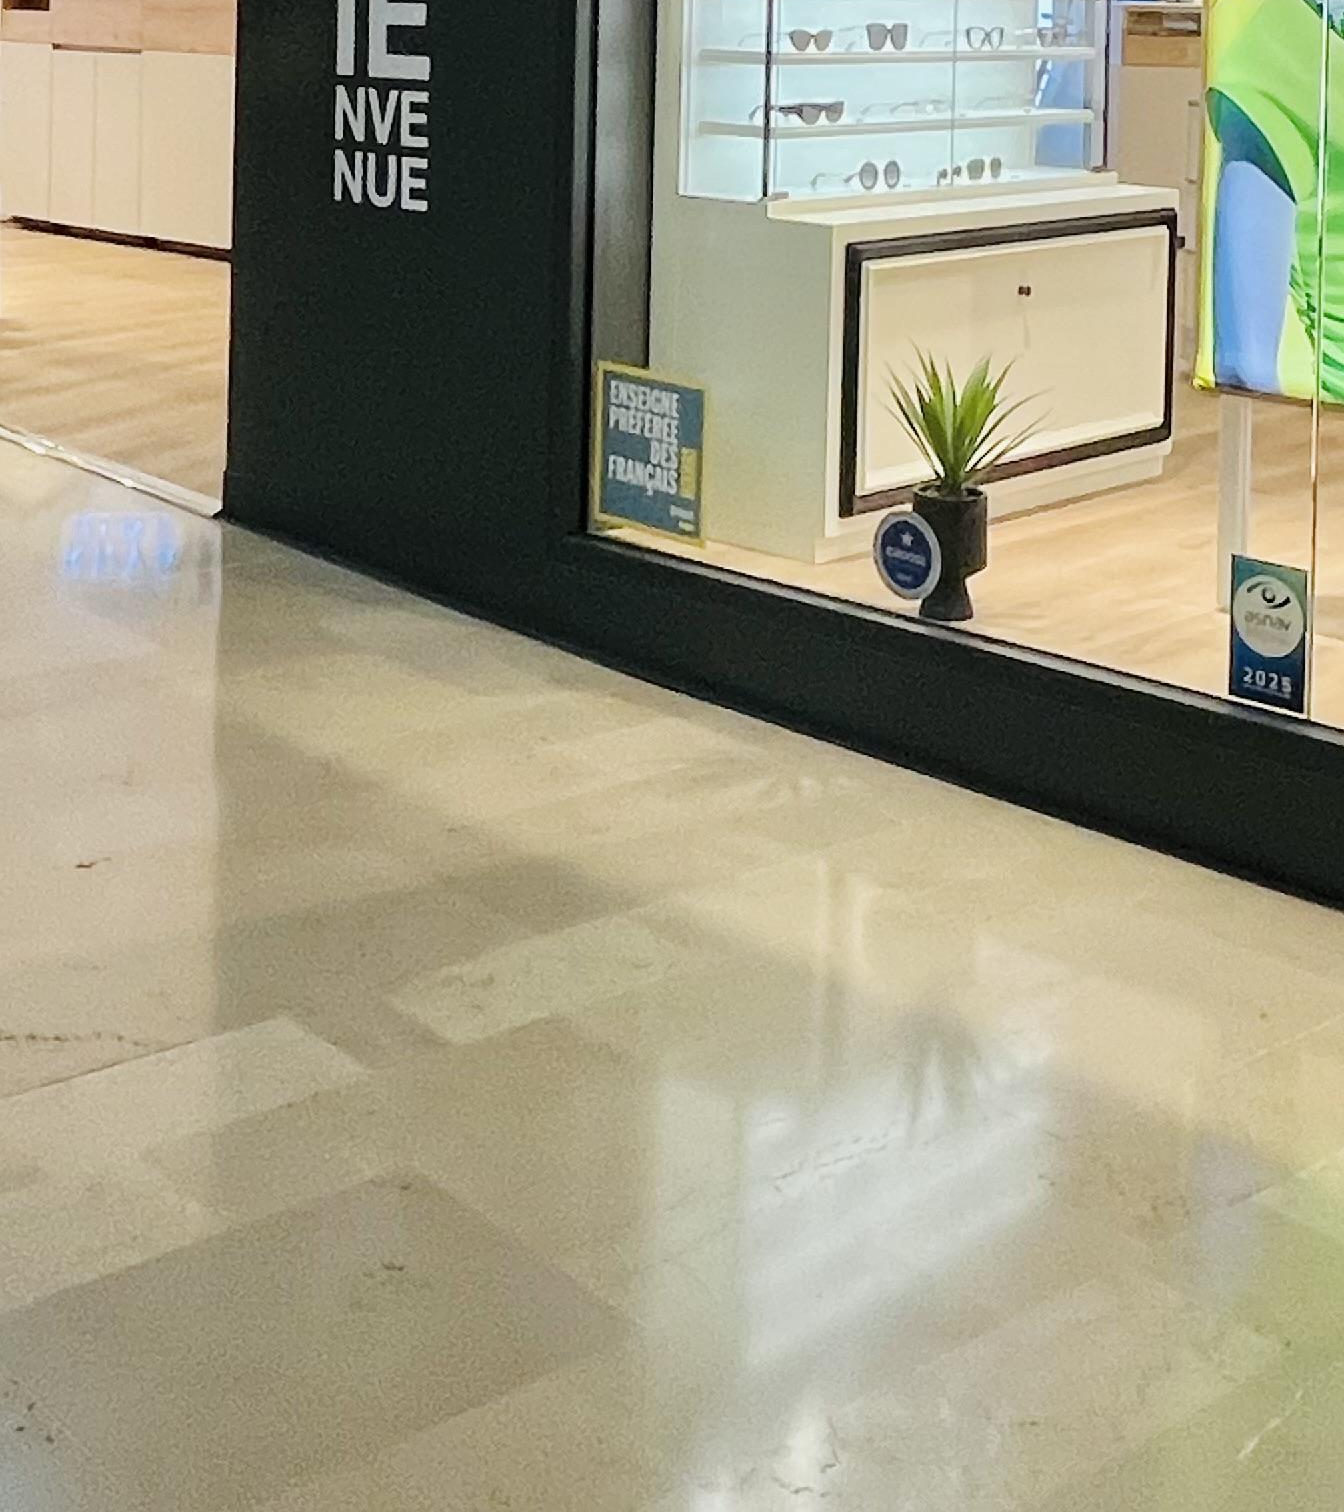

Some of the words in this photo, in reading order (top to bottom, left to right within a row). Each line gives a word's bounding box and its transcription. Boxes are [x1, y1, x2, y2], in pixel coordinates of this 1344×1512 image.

[609, 379, 681, 418] ENSEIGNE
[649, 439, 679, 471] DES
[607, 453, 679, 497] FRANÇAIS
[1242, 666, 1293, 694] 2025
